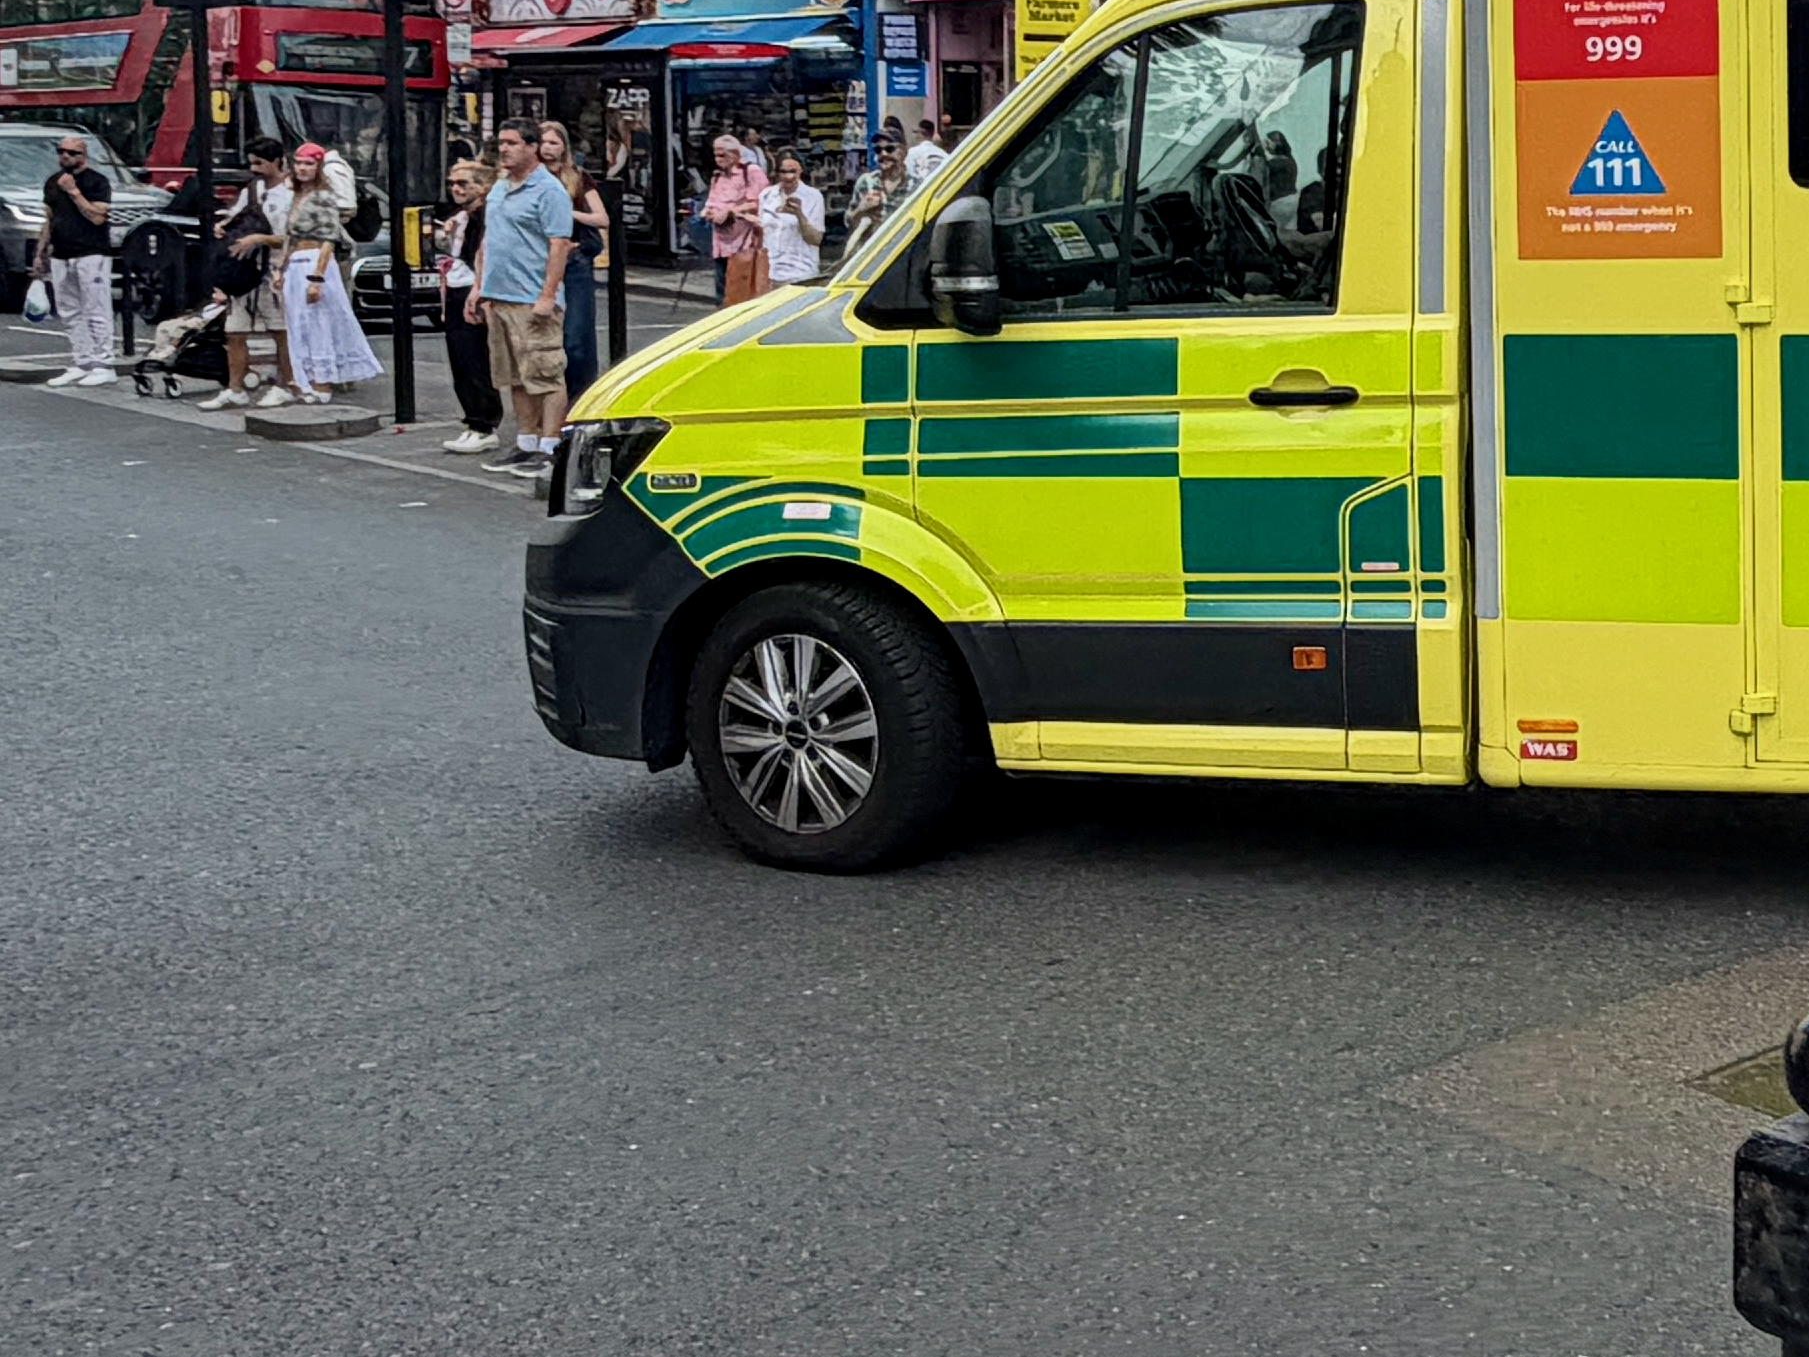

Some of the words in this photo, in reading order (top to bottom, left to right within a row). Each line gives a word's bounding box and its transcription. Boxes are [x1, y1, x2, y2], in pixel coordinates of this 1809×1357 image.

[1028, 10, 1076, 22] Market
[1585, 35, 1642, 61] 999
[1595, 141, 1636, 154] CALL
[1587, 158, 1642, 186] 111
[1527, 742, 1569, 756] WAS
